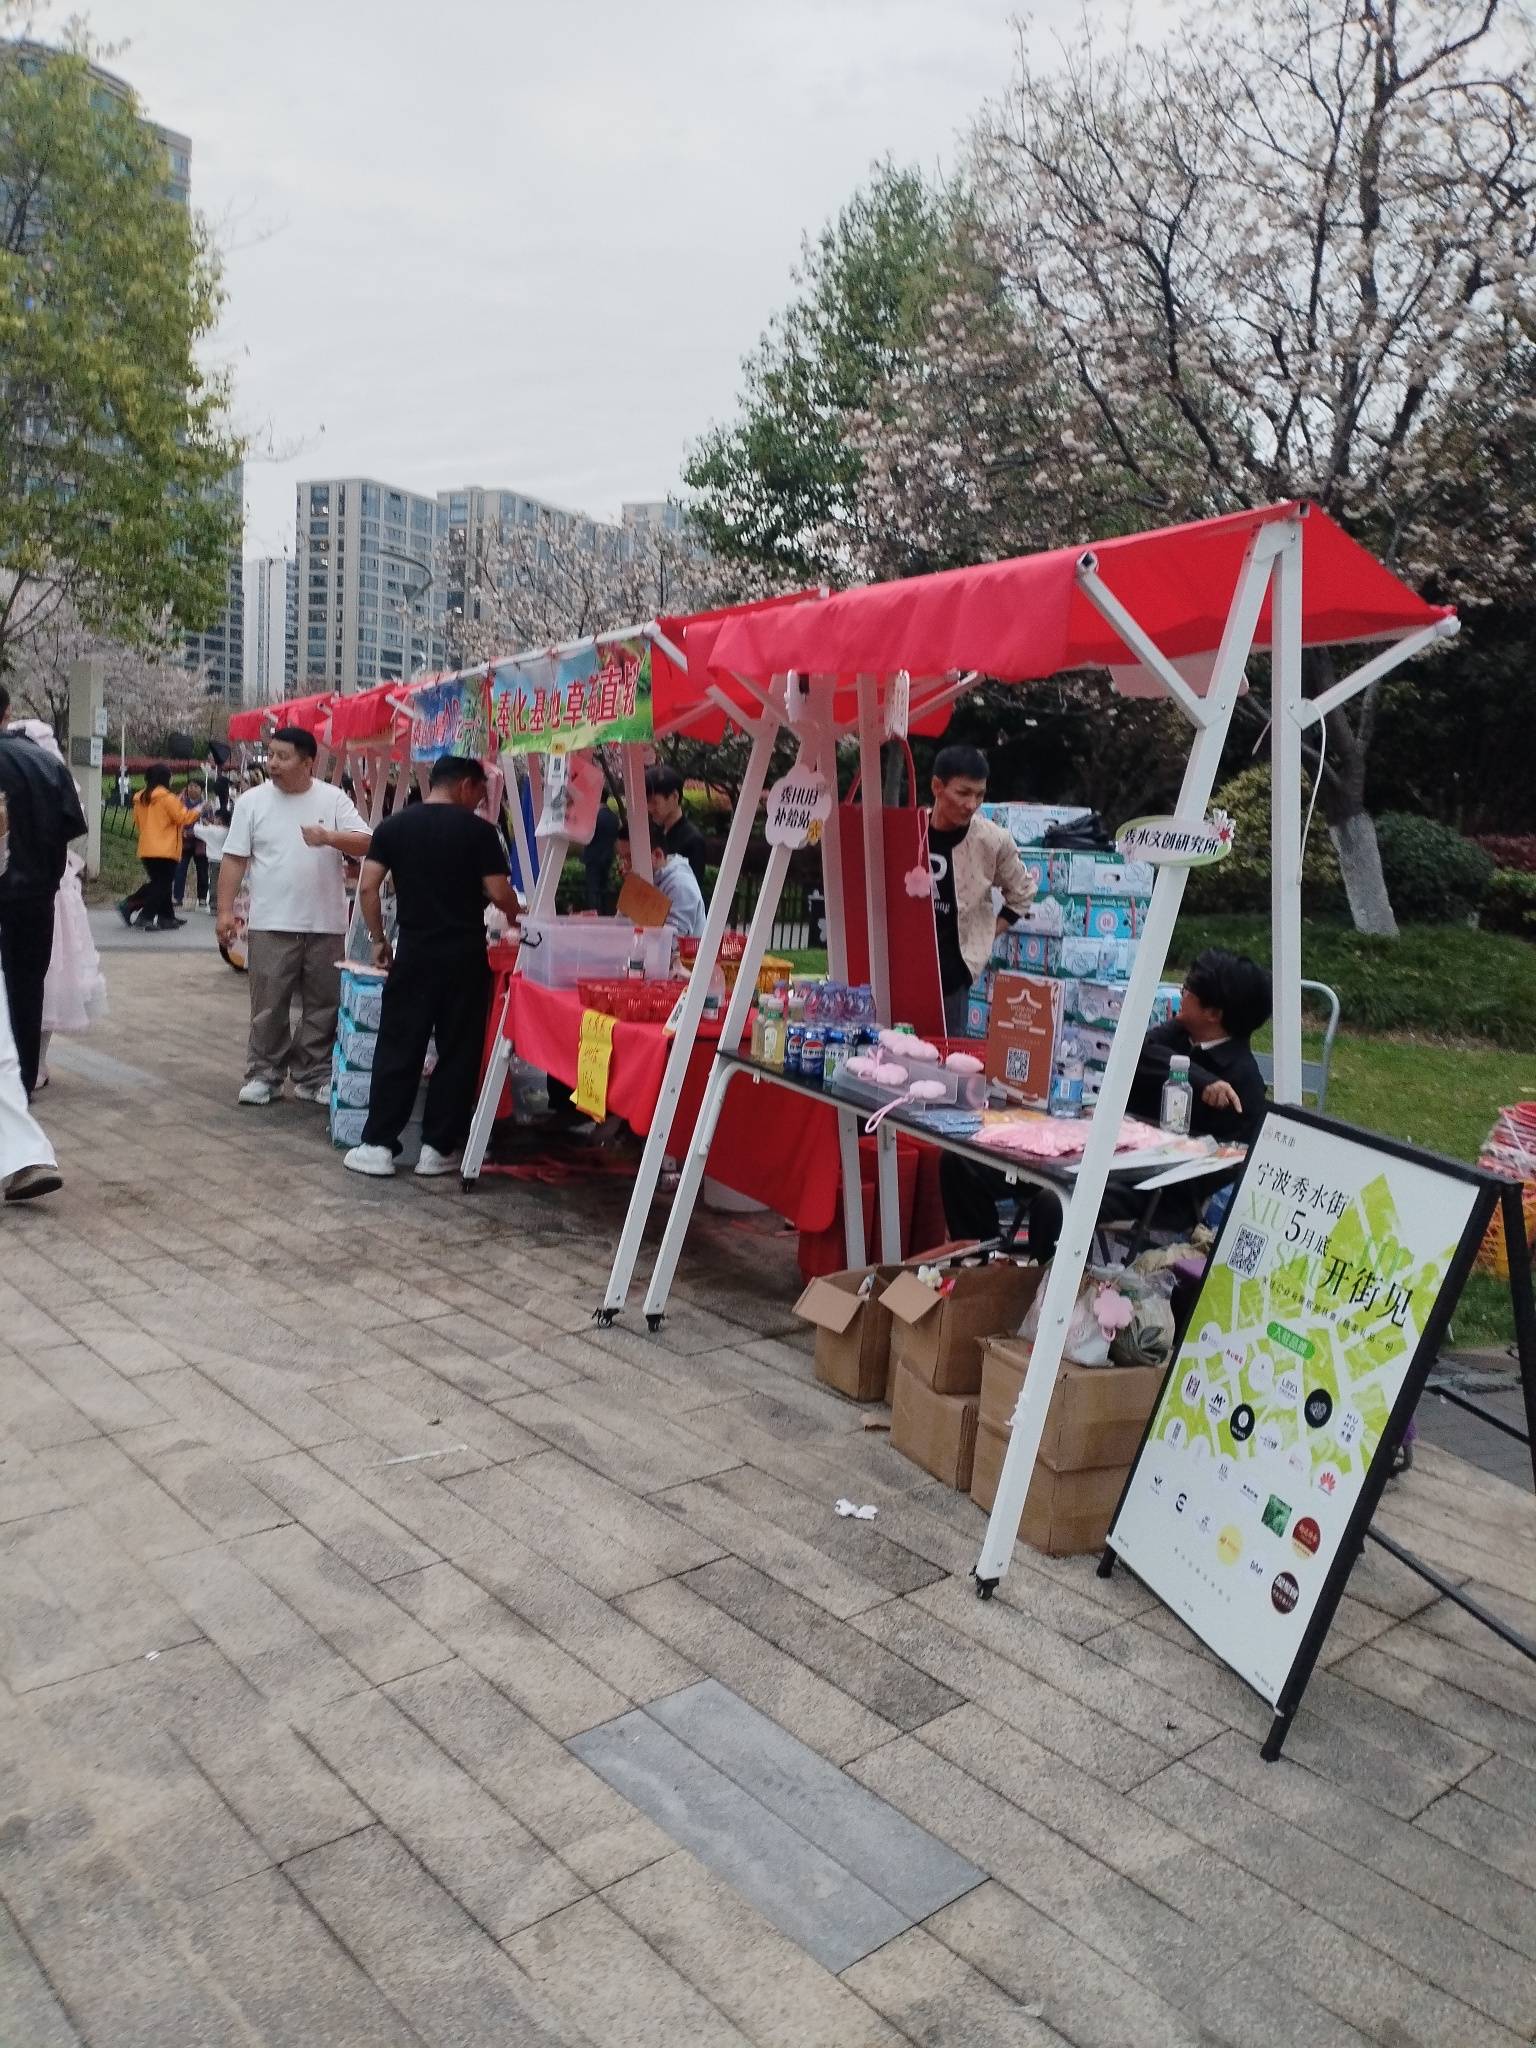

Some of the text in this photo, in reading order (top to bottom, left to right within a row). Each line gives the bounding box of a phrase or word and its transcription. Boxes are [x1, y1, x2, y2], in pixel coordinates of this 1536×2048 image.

[774, 807, 811, 829] 补给站
[1124, 827, 1220, 856] 秀水文创研究所
[1258, 1162, 1351, 1219] 宁波秀水街
[1285, 1210, 1332, 1257] 5月底
[1318, 1255, 1413, 1328] 开街见
